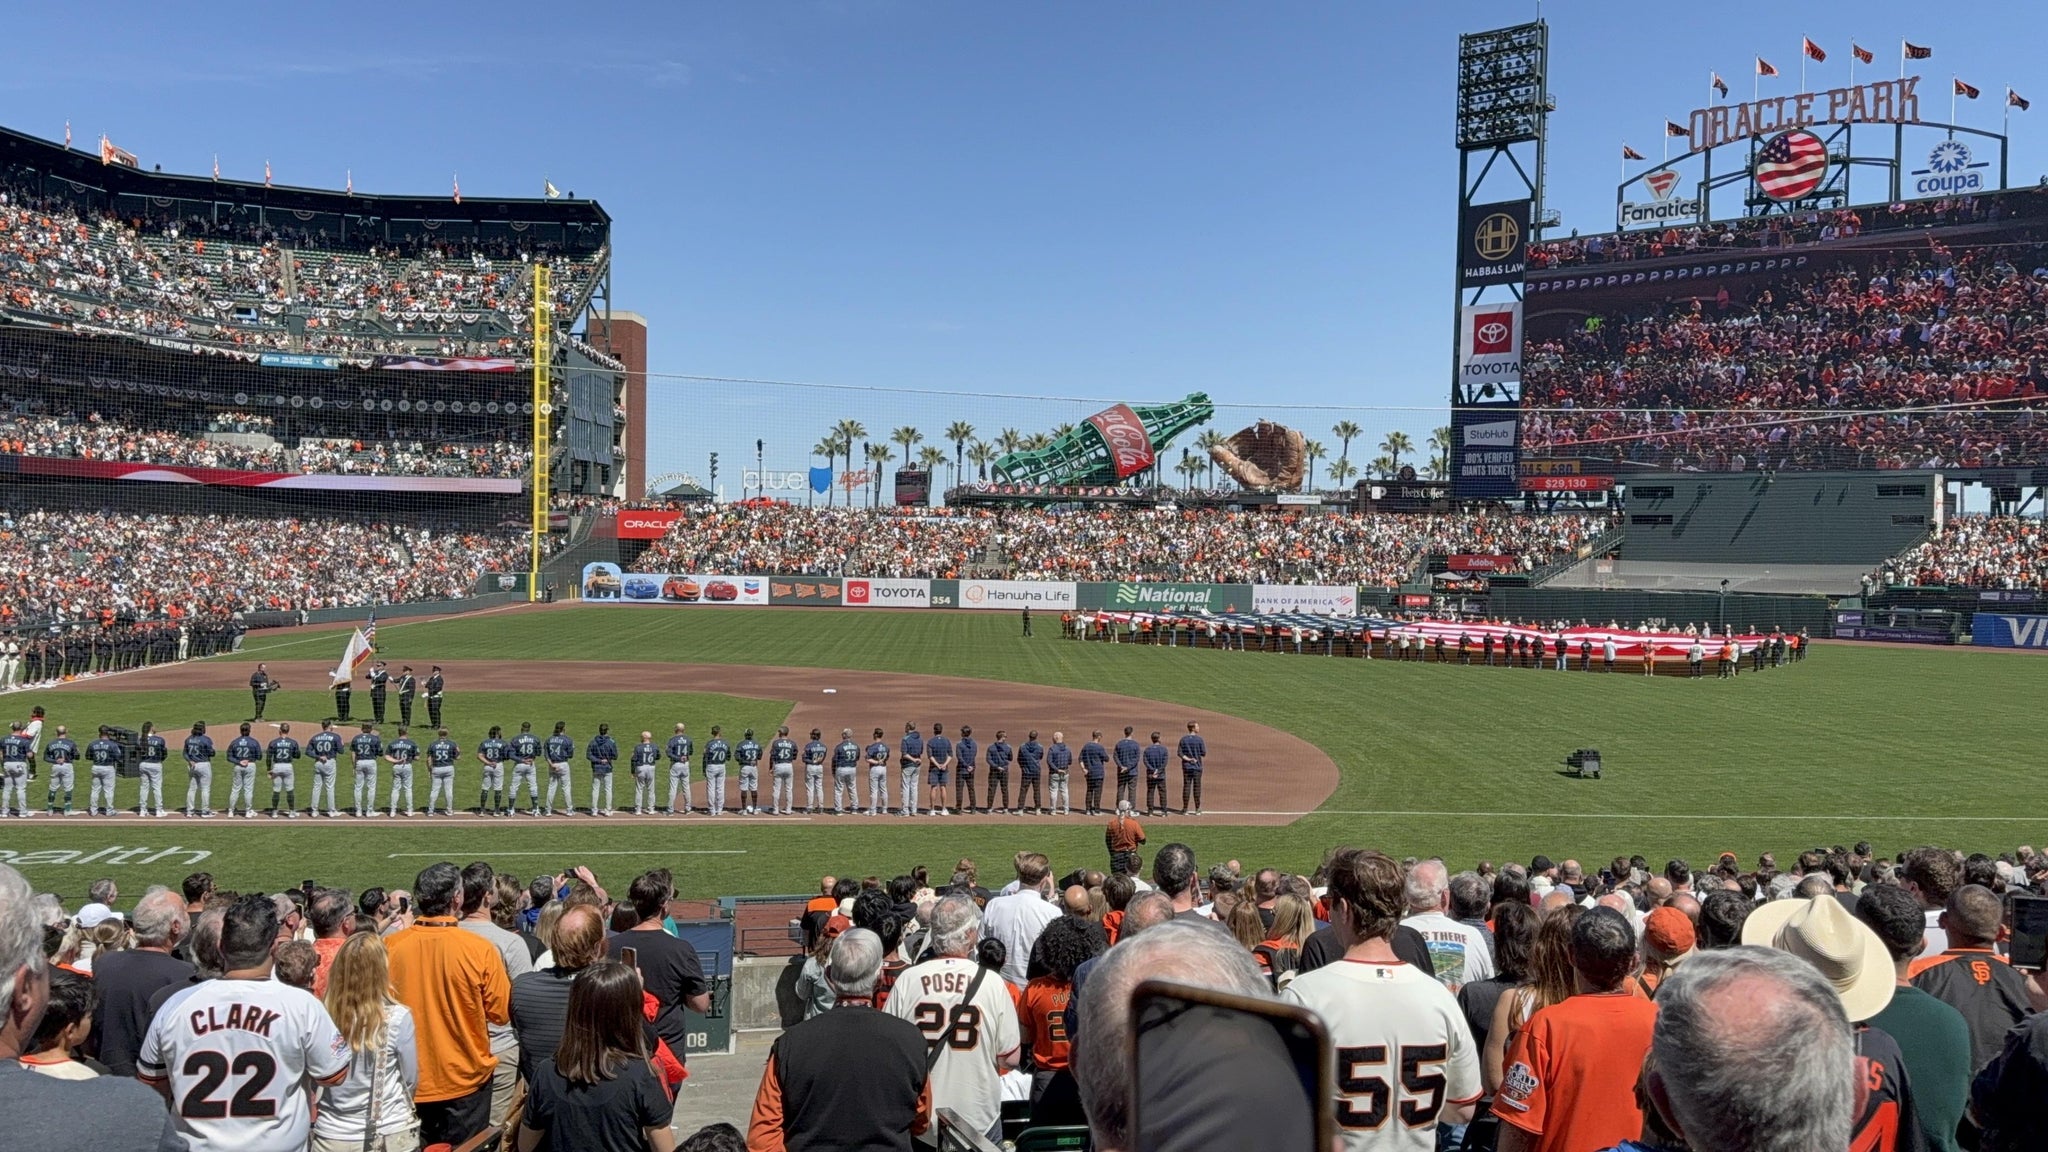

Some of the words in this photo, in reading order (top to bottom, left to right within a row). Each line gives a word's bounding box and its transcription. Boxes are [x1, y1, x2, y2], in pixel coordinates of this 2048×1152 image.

[1688, 92, 1815, 153] ORACLE
[1827, 75, 1922, 125] PARK
[1916, 174, 1981, 195] coupa
[1621, 199, 1700, 222] Fanatics
[1465, 264, 1503, 278] HABBAS
[1505, 263, 1525, 273] LAW
[150, 338, 162, 346] MLB
[163, 340, 191, 350] NETWORK
[1463, 361, 1521, 376] TOYOTA
[1470, 429, 1509, 440] StubHub
[1465, 452, 1483, 464] 100%
[1484, 452, 1514, 463] VERIFIED
[1462, 465, 1487, 476] GIANTS
[1488, 465, 1516, 476] TICKETS
[743, 466, 804, 489] blue
[1545, 479, 1587, 490] $29,130
[1421, 487, 1445, 499] Coffee
[624, 520, 675, 529] ORACLE
[1467, 558, 1495, 567] Adobe
[874, 587, 926, 599] TOYOTA
[987, 590, 1042, 601] Hanwha
[1045, 590, 1070, 602] Life
[1138, 587, 1212, 603] National
[932, 596, 951, 605] 354
[1293, 598, 1334, 606] AMERICA
[1647, 617, 1667, 627] 391
[2000, 617, 2048, 646] VI
[5, 745, 18, 756] 18
[188, 745, 200, 756] 75
[236, 747, 250, 758] 22
[316, 741, 332, 753] 60
[357, 745, 370, 755] 52
[520, 744, 533, 755] 48
[549, 744, 560, 755] 54
[677, 745, 688, 755] 14
[95, 751, 107, 761] 39
[276, 748, 289, 759] 25
[435, 750, 449, 760] 55
[486, 748, 499, 759] 83
[642, 752, 654, 763] 16
[711, 751, 725, 761] 70
[745, 750, 757, 760] 53
[779, 748, 791, 759] 45
[846, 751, 857, 761] 33
[0, 846, 213, 865] alth
[1432, 931, 1468, 944] THERE
[190, 1003, 282, 1038] CLARK
[914, 1003, 981, 1051] 28
[687, 1032, 707, 1048] 08
[181, 1050, 277, 1119] 22
[1334, 1043, 1448, 1131] 55
